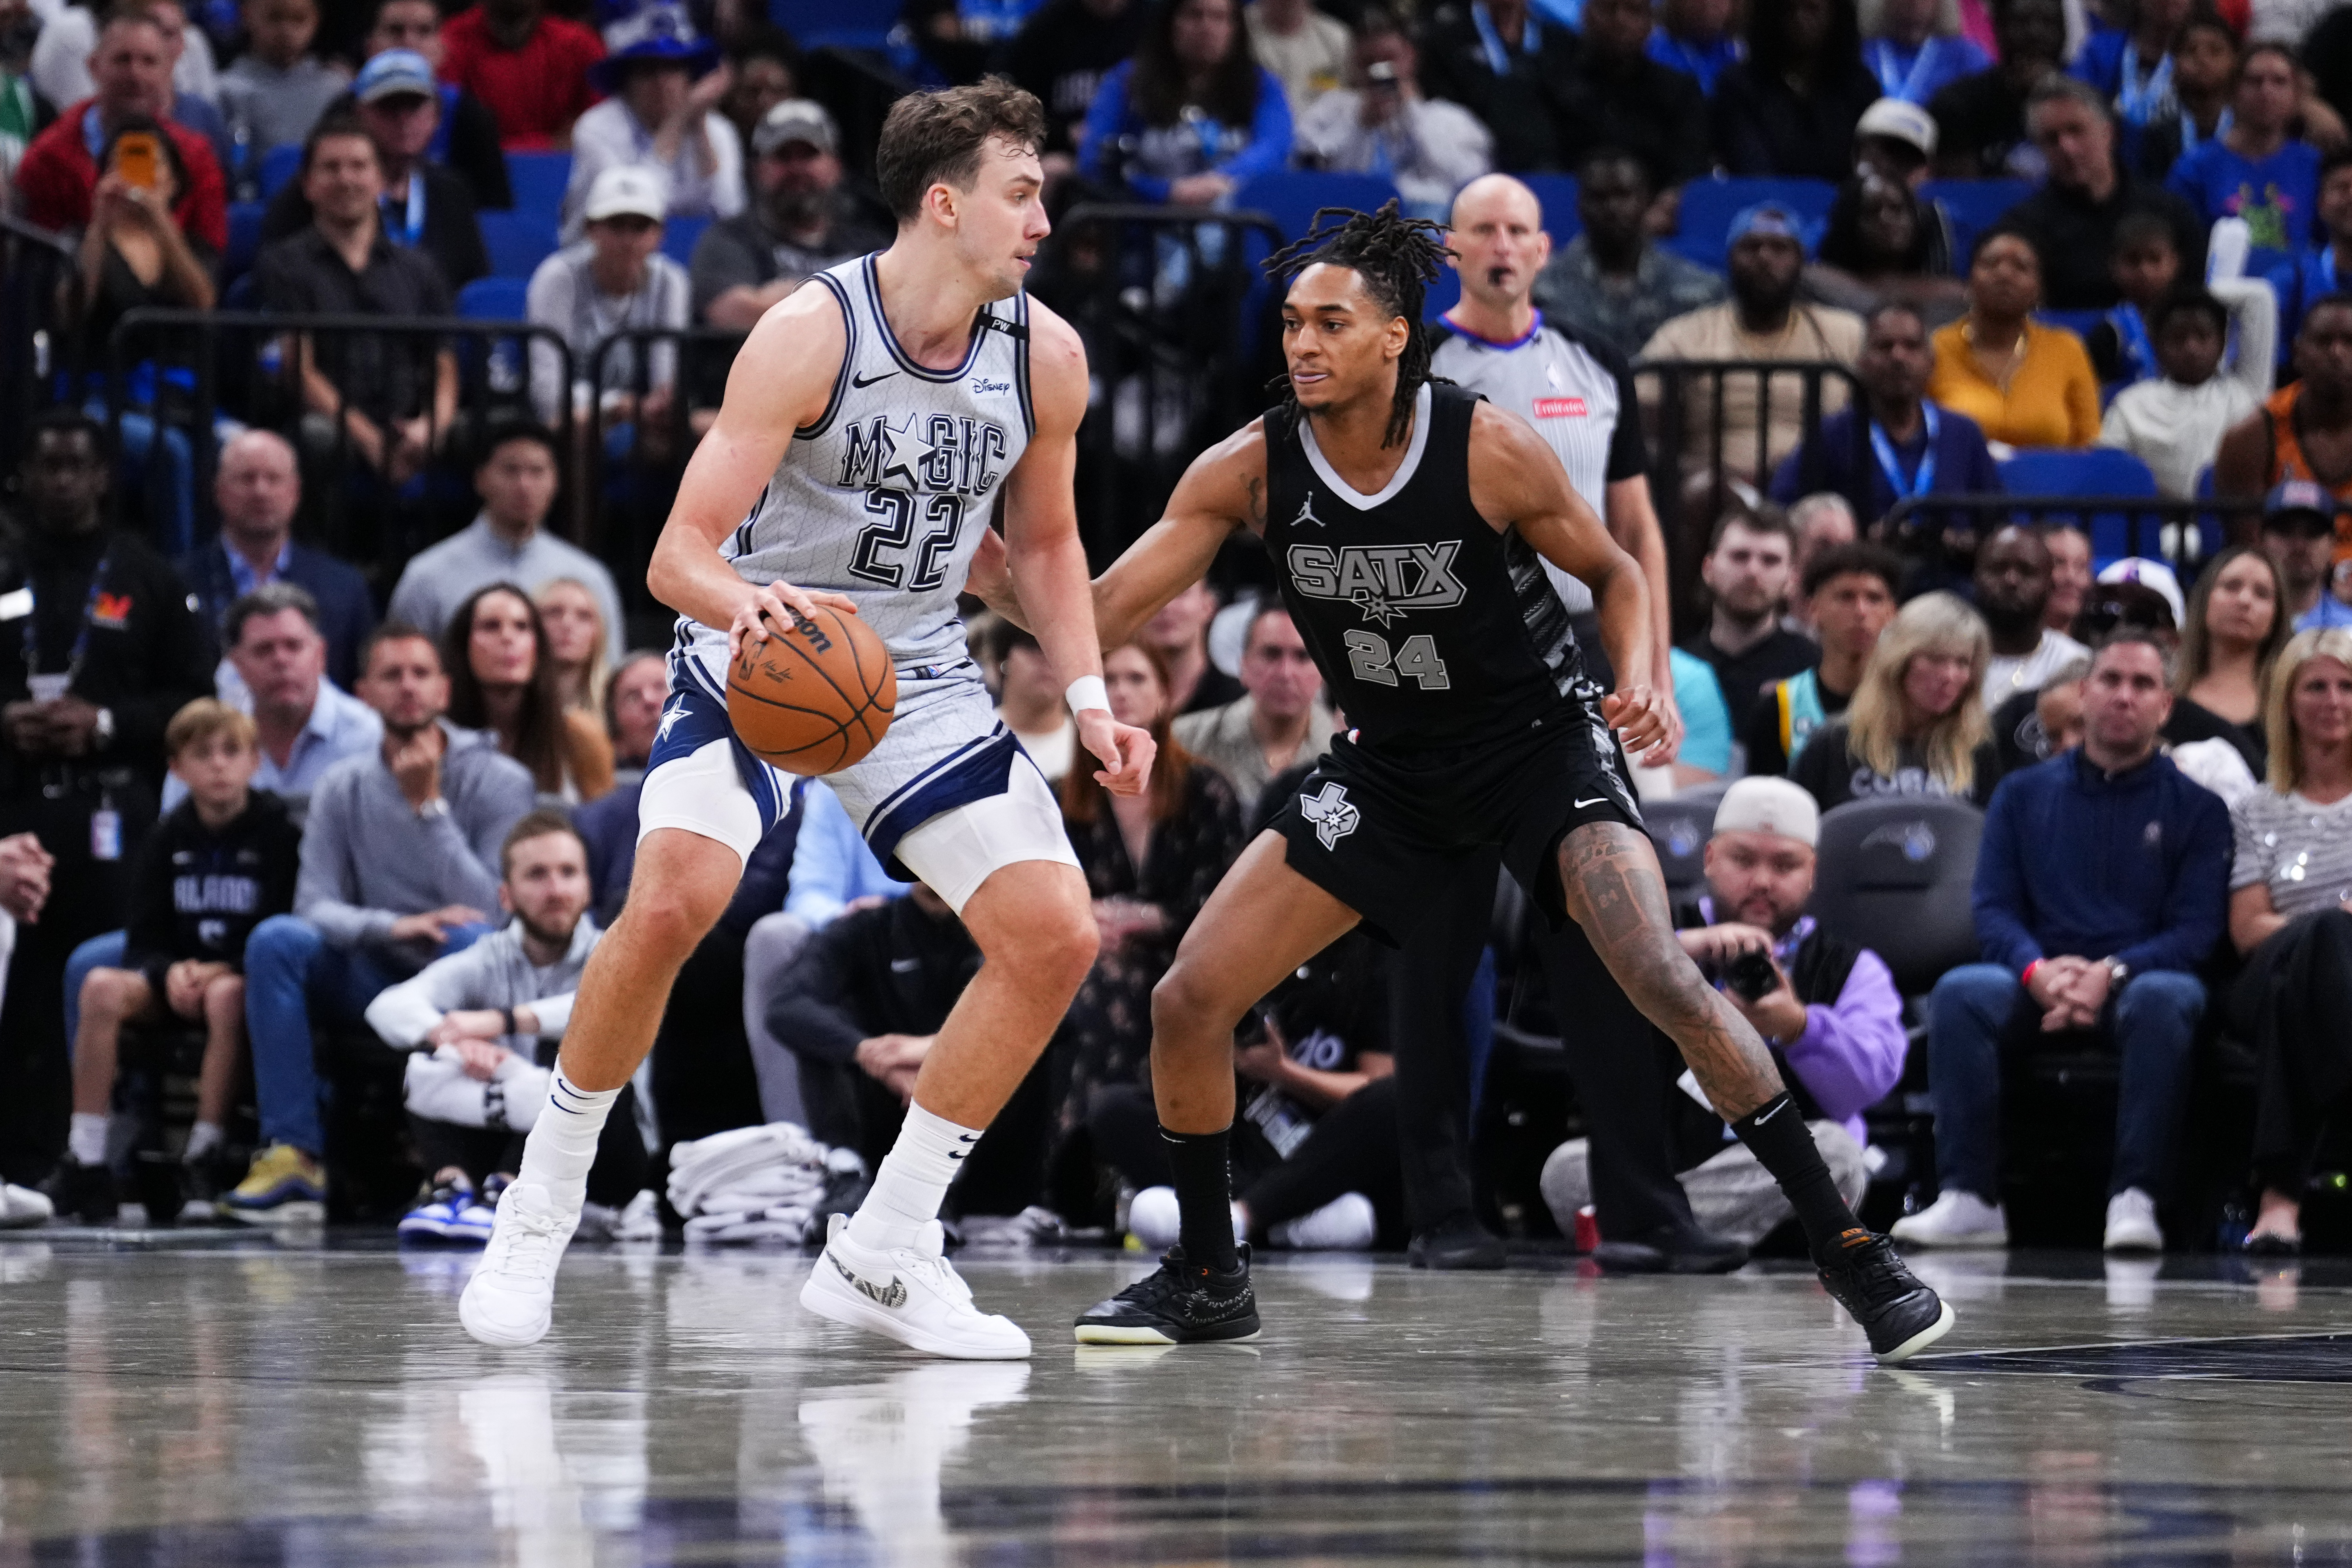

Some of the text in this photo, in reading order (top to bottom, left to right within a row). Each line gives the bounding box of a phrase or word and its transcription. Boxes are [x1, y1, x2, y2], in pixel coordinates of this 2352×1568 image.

[992, 319, 1011, 332] PW
[970, 378, 1010, 396] Disney
[838, 413, 1006, 496] MAGIC
[847, 487, 966, 592] 22
[1287, 539, 1467, 609] SATX
[1343, 628, 1451, 690] 24
